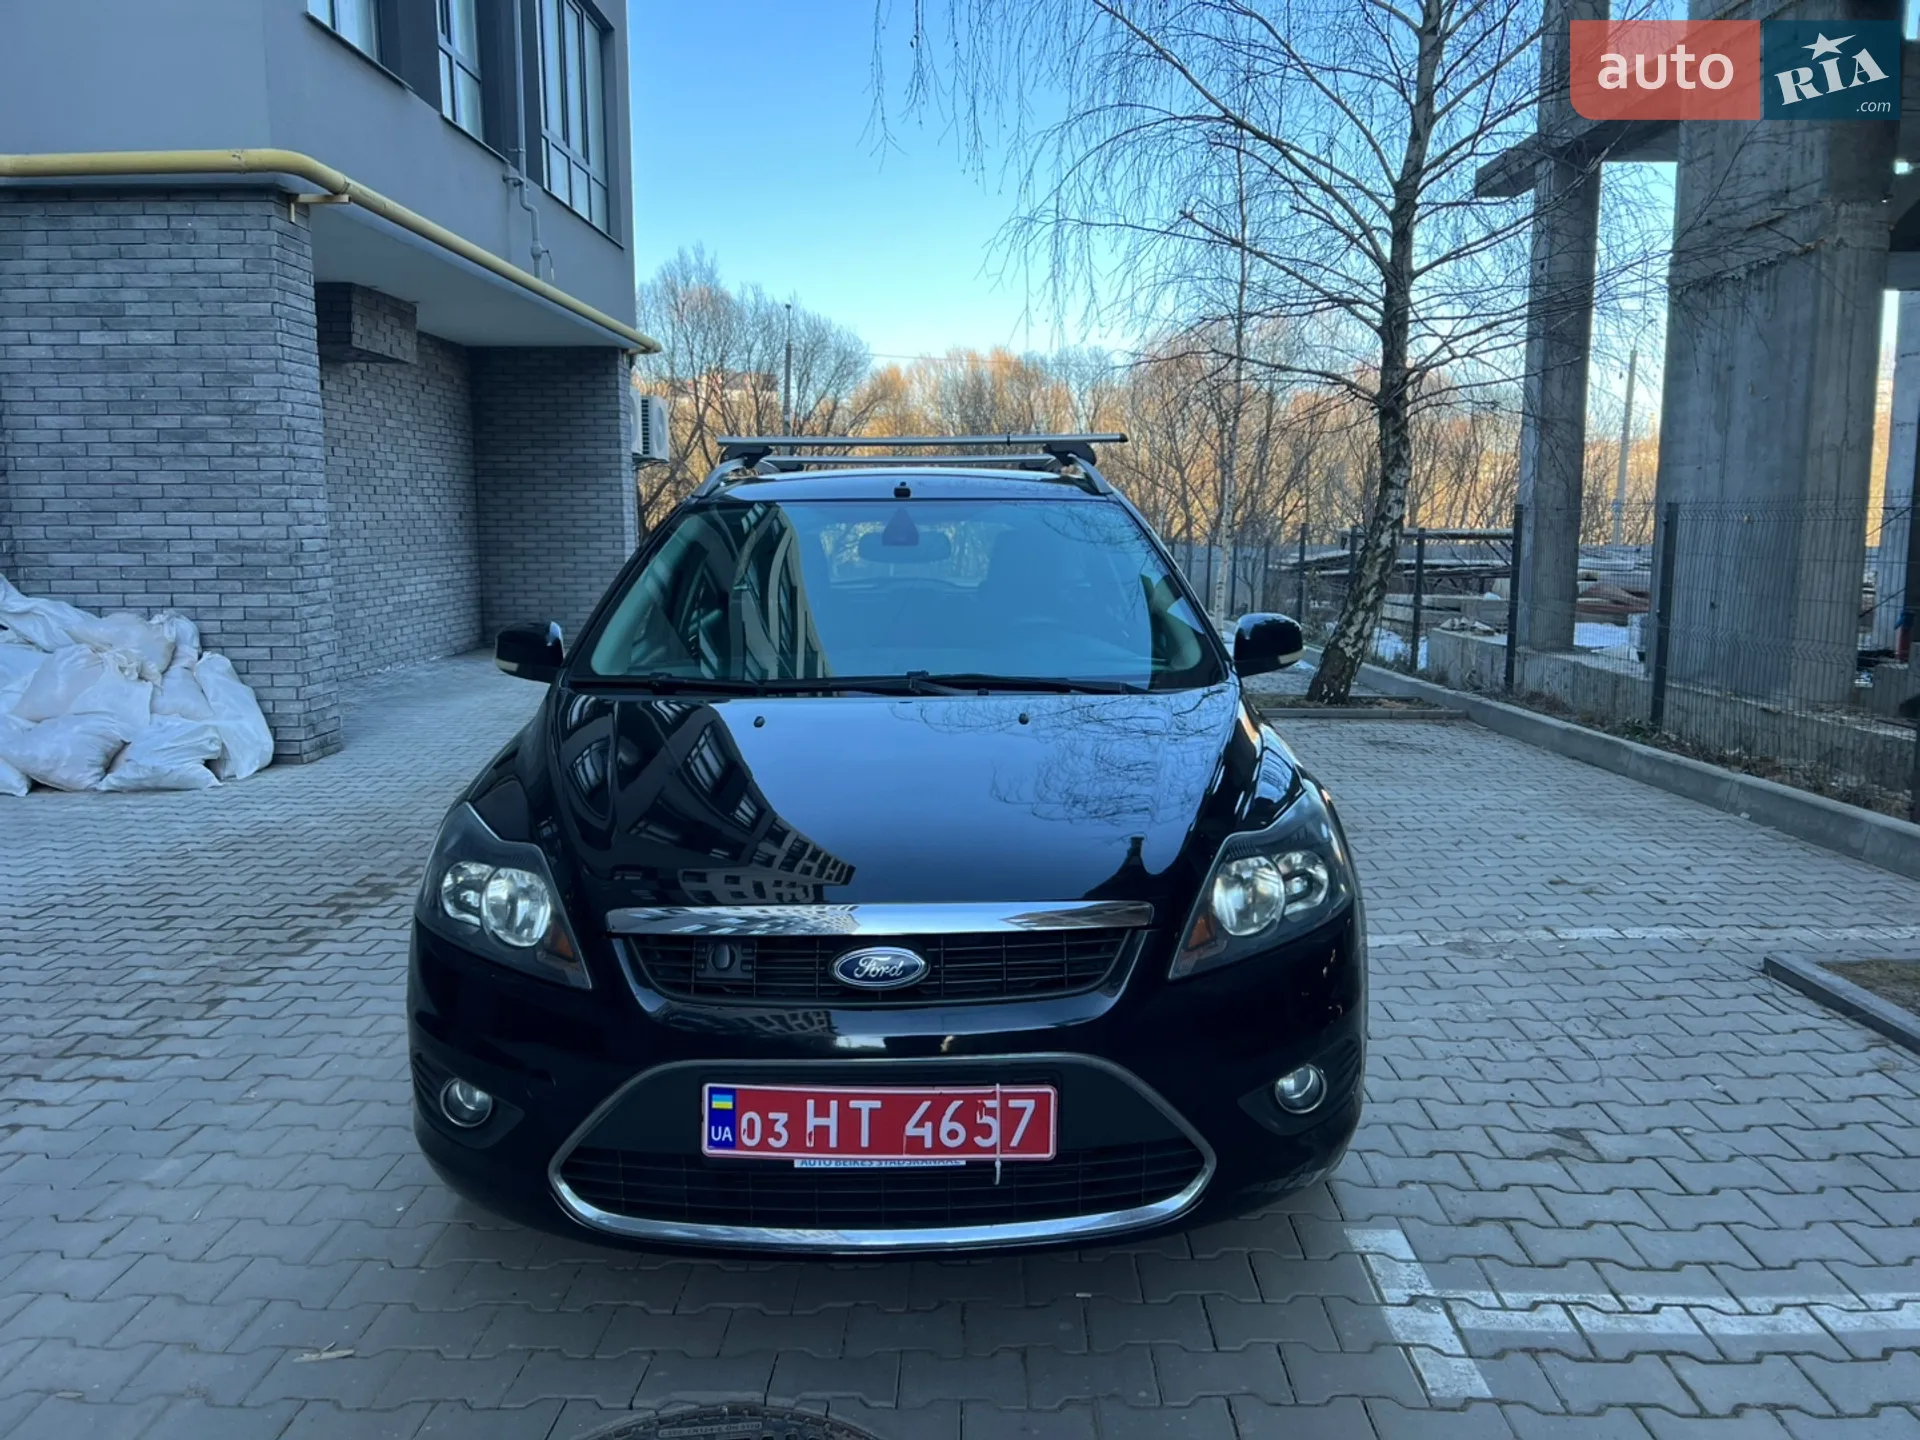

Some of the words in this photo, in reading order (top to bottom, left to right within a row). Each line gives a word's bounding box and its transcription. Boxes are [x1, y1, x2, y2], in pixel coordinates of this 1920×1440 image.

[853, 956, 904, 978] Ford
[711, 1126, 733, 1142] UA
[740, 1112, 789, 1147] 03
[806, 1099, 882, 1147] HT
[905, 1100, 1036, 1148] 4657
